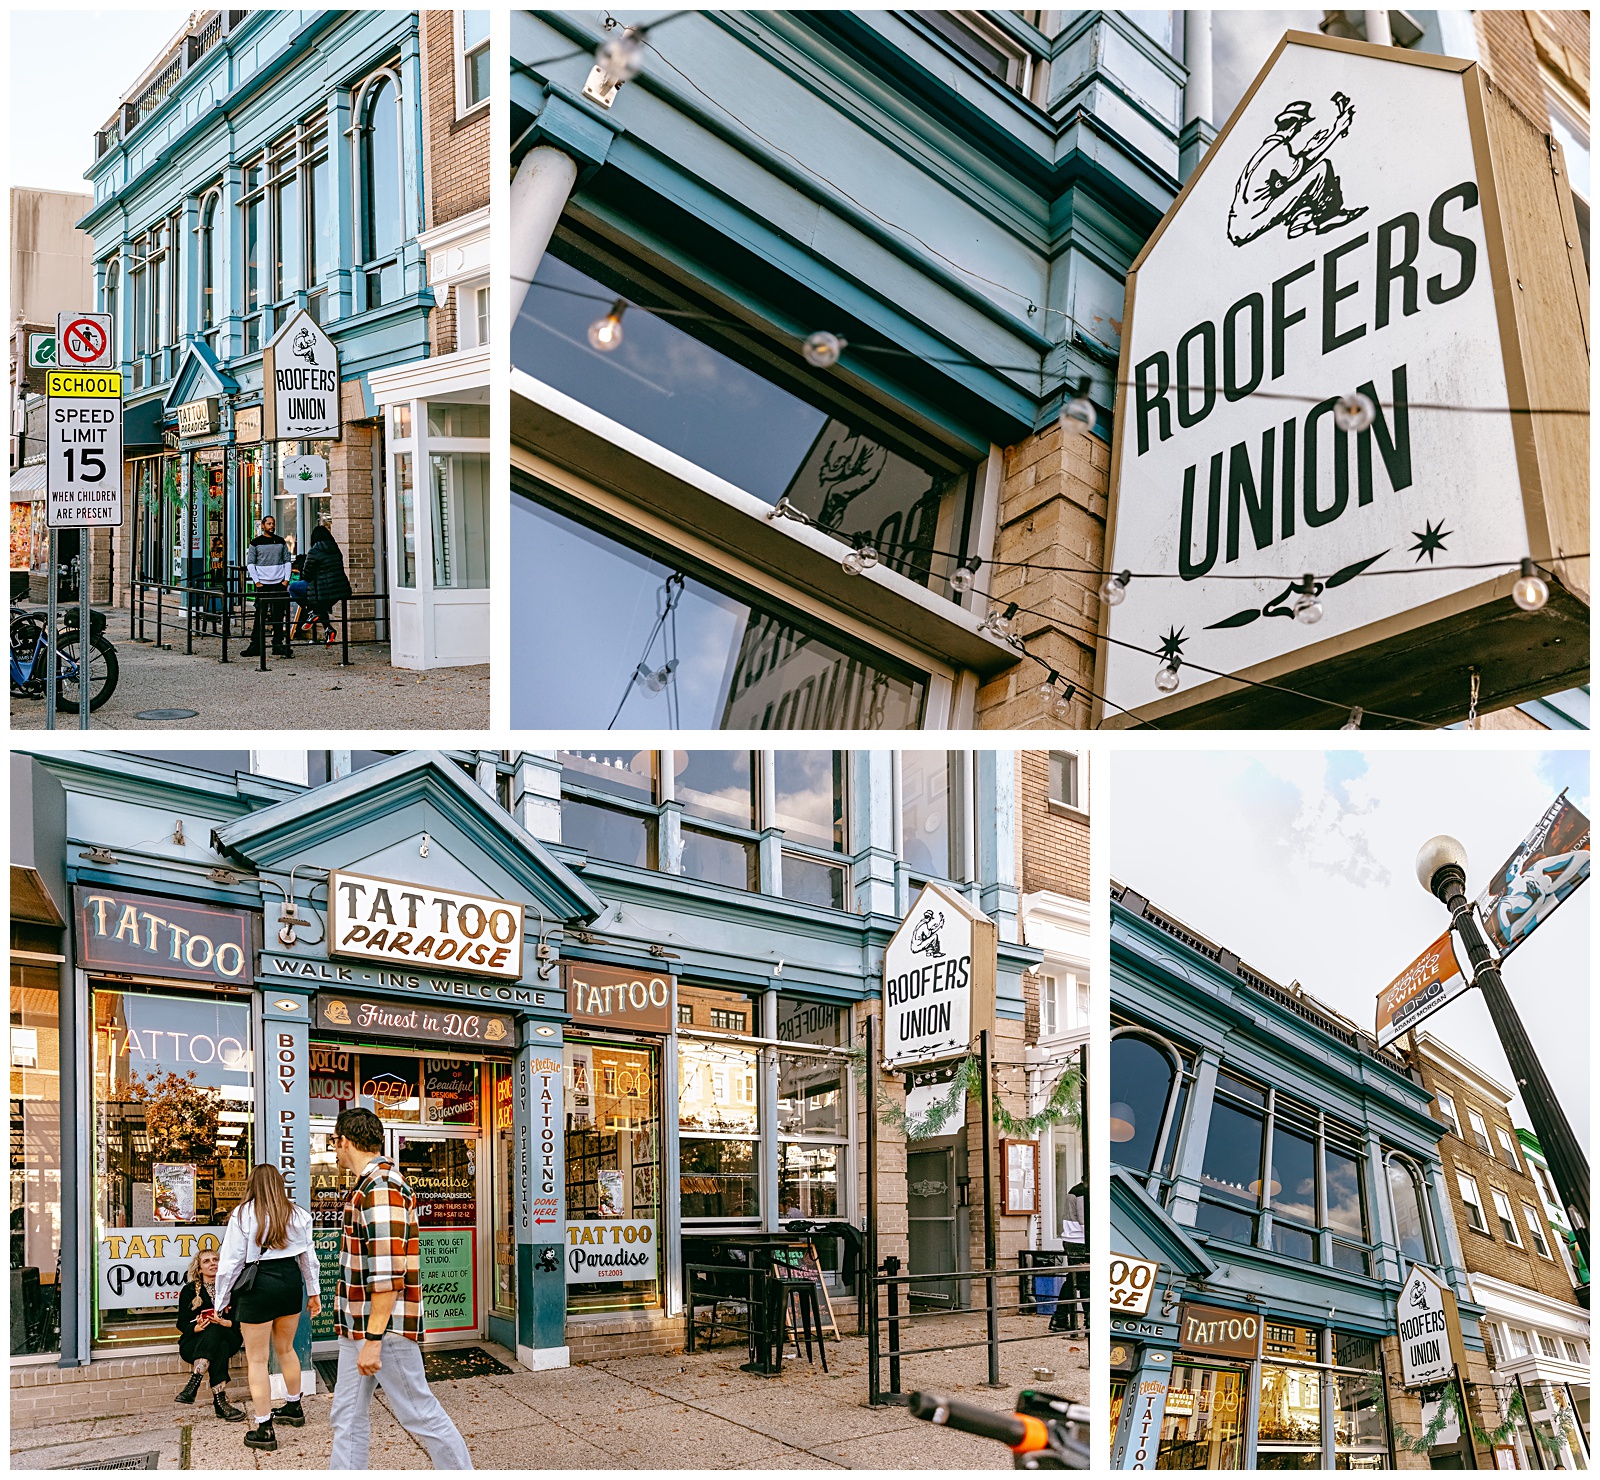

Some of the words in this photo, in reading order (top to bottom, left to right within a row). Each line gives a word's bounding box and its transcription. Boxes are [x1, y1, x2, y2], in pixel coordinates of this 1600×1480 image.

[1136, 181, 1479, 457] ROOFERS
[52, 377, 118, 393] SCHOOL
[276, 368, 336, 392] ROOFERS
[54, 408, 115, 424] SPEED
[178, 403, 208, 424] TATTOO
[288, 397, 326, 420] UNION
[61, 428, 108, 443] LIMIT
[63, 448, 107, 482] 15
[1178, 364, 1414, 582] UNION
[52, 491, 74, 502] WHEN
[77, 490, 117, 502] CHILDREN
[56, 507, 73, 519] ARE
[76, 507, 113, 518] PRESENT
[338, 881, 518, 945] TATTOO
[84, 894, 246, 979] TATTOO
[342, 924, 512, 968] PARADISE
[273, 958, 353, 981] WALK
[378, 972, 421, 989] INS
[430, 979, 546, 1005] WELCOME
[887, 955, 971, 1008] ROOFERS
[572, 977, 670, 1016] TATTOO
[1416, 994, 1447, 1018] MORGAN
[356, 1003, 419, 1031] Finest
[423, 1010, 441, 1031] in
[442, 1013, 481, 1039] D.C.
[899, 1001, 952, 1041] UNION
[97, 1025, 244, 1065] TATTOO
[277, 1033, 296, 1095] BODY
[530, 1057, 561, 1075] Electric
[309, 1079, 354, 1100] MOUS
[362, 1080, 414, 1101] OPEN
[426, 1077, 474, 1094] Beautiful
[520, 1060, 528, 1112] BODY
[563, 1065, 651, 1095] TATTOO
[540, 1075, 555, 1196] TATTOOING
[278, 1110, 297, 1200] PIERCI
[310, 1174, 358, 1188] TATT
[405, 1175, 470, 1188] Paradise
[521, 1125, 529, 1230] PIERCING
[317, 1191, 340, 1199] OPEN
[533, 1198, 559, 1206] DONE
[533, 1208, 558, 1216] HERE
[102, 1233, 222, 1259] TATTO
[314, 1240, 338, 1251] hop
[418, 1239, 434, 1247] SURE
[452, 1238, 464, 1246] GET
[566, 1225, 653, 1246] TATTOO
[425, 1256, 451, 1264] STUDIO.
[439, 1247, 459, 1255] RIGHT
[568, 1248, 650, 1273] Paradise
[107, 1264, 188, 1297] Para
[427, 1271, 439, 1279] ARE
[447, 1270, 458, 1278] LOT
[460, 1270, 468, 1278] OF
[422, 1282, 459, 1293] AKERS
[423, 1293, 467, 1305] TOOING
[444, 1308, 467, 1318] AREA.
[1111, 1319, 1164, 1336] COME
[1186, 1316, 1259, 1345] TATTOO
[1400, 1310, 1445, 1342] ROOFERS
[1410, 1338, 1441, 1368] UNION
[1139, 1380, 1166, 1396] Electric
[1133, 1397, 1157, 1470] TATTO
